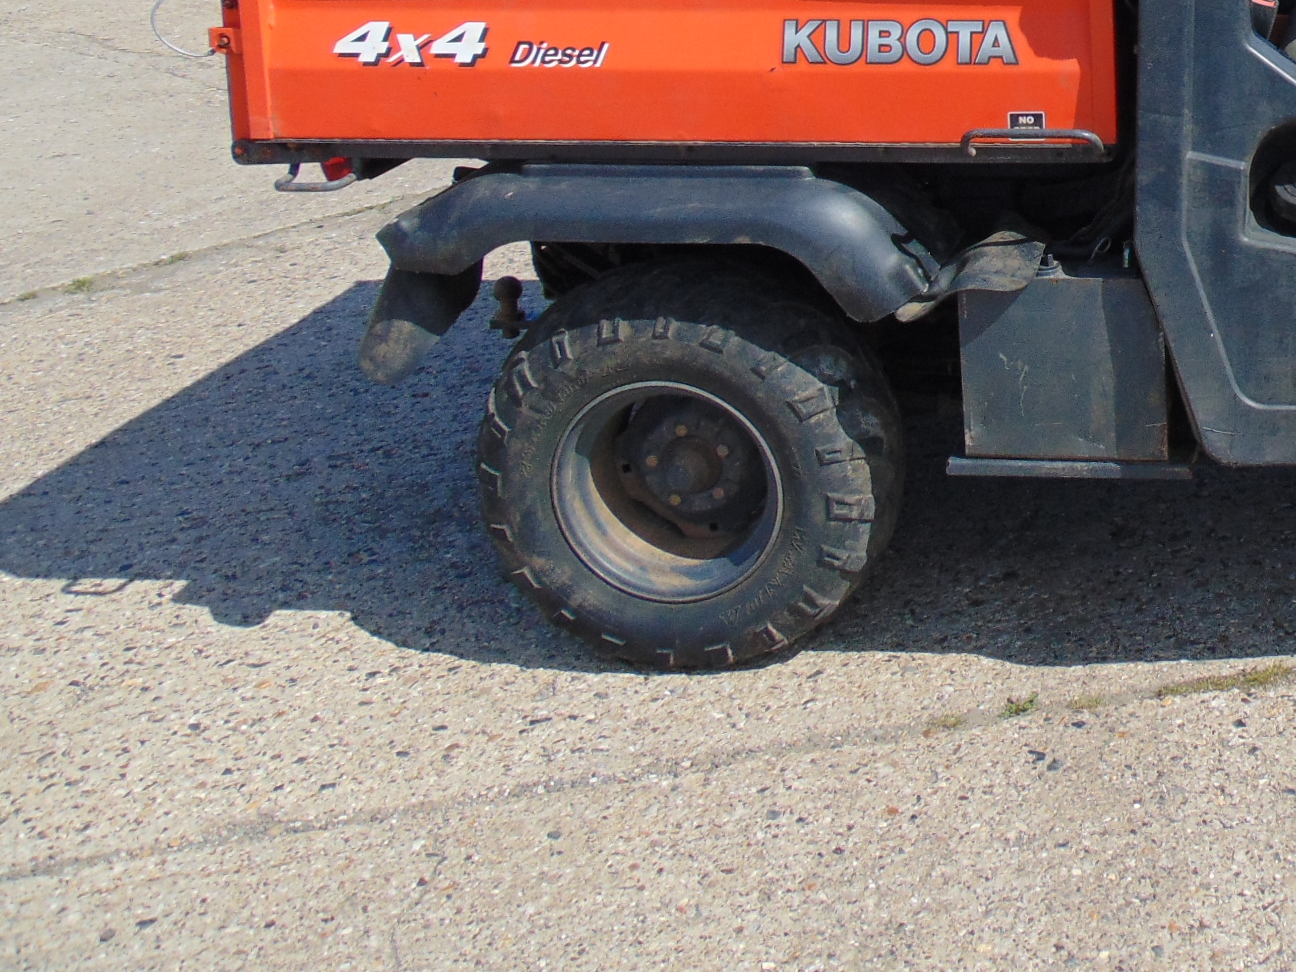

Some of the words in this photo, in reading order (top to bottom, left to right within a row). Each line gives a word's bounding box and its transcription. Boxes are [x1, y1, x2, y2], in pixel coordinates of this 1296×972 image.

[332, 20, 489, 67] 4x4
[508, 41, 610, 68] Diesel
[782, 18, 1019, 66] KUBOTA
[1018, 115, 1035, 125] NO
